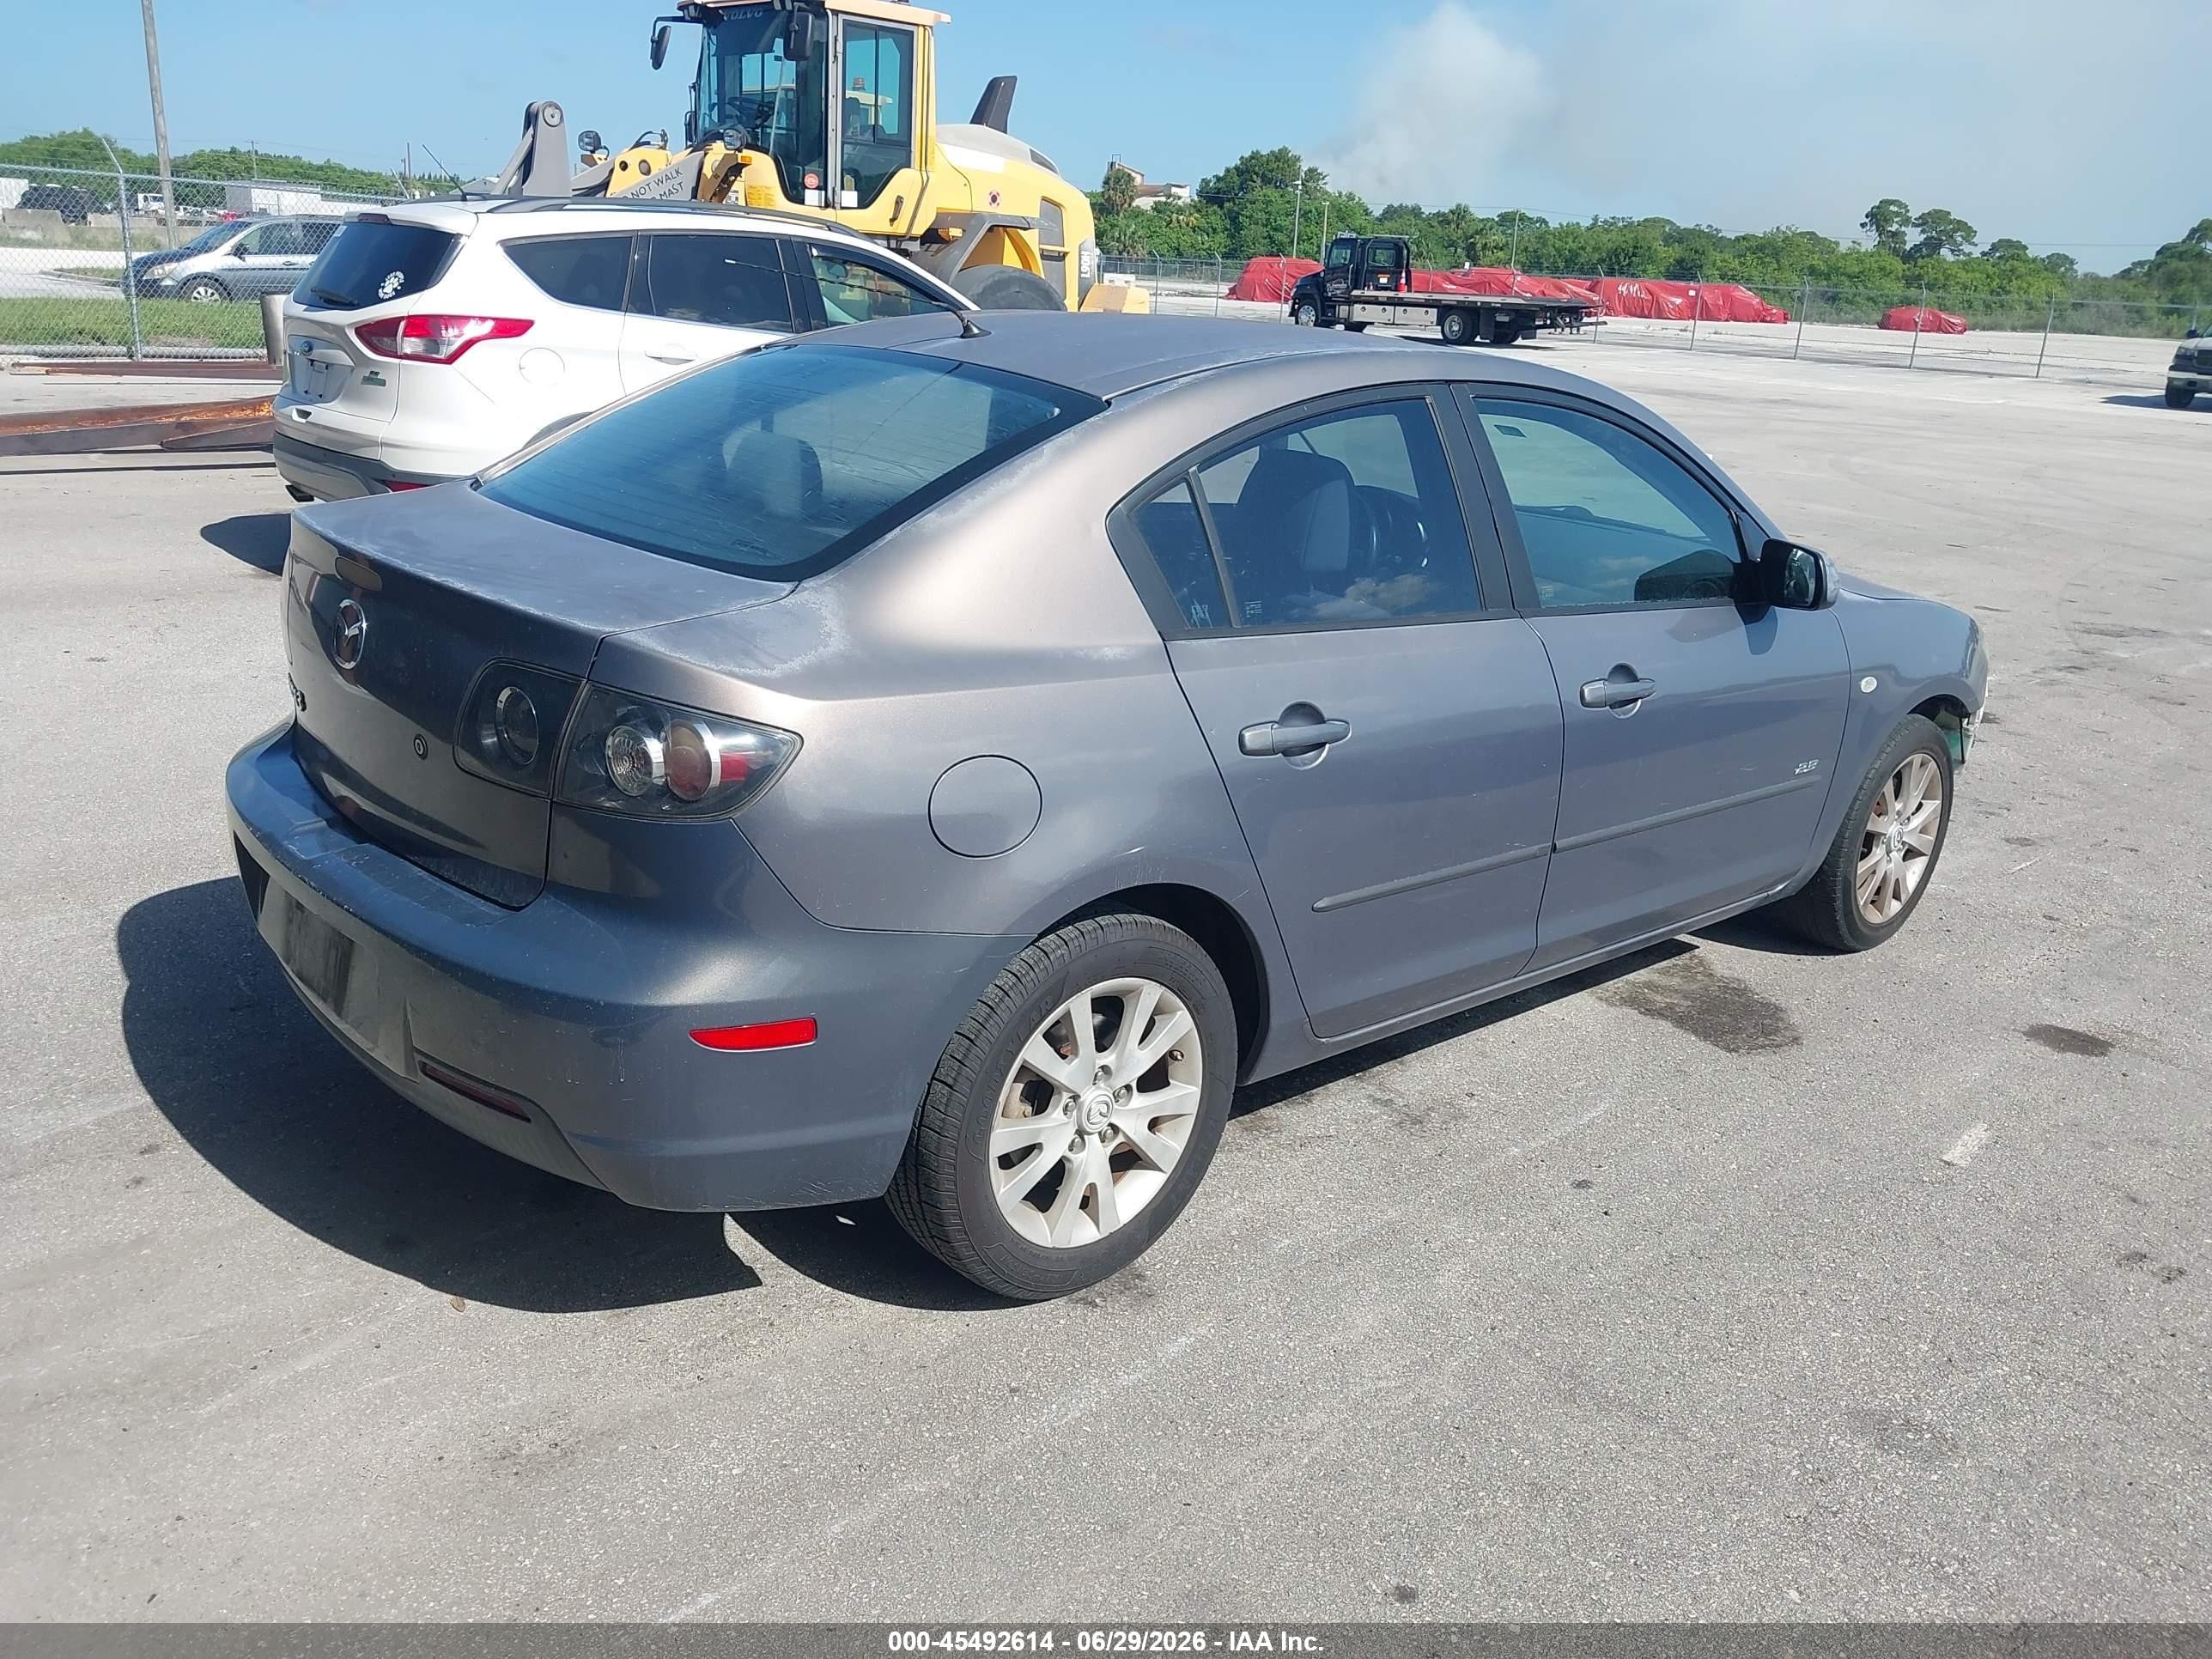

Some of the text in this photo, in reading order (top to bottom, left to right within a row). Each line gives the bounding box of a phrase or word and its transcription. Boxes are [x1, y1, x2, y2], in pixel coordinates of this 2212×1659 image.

[630, 167, 683, 198] NOT WALK
[659, 181, 684, 199] MAST
